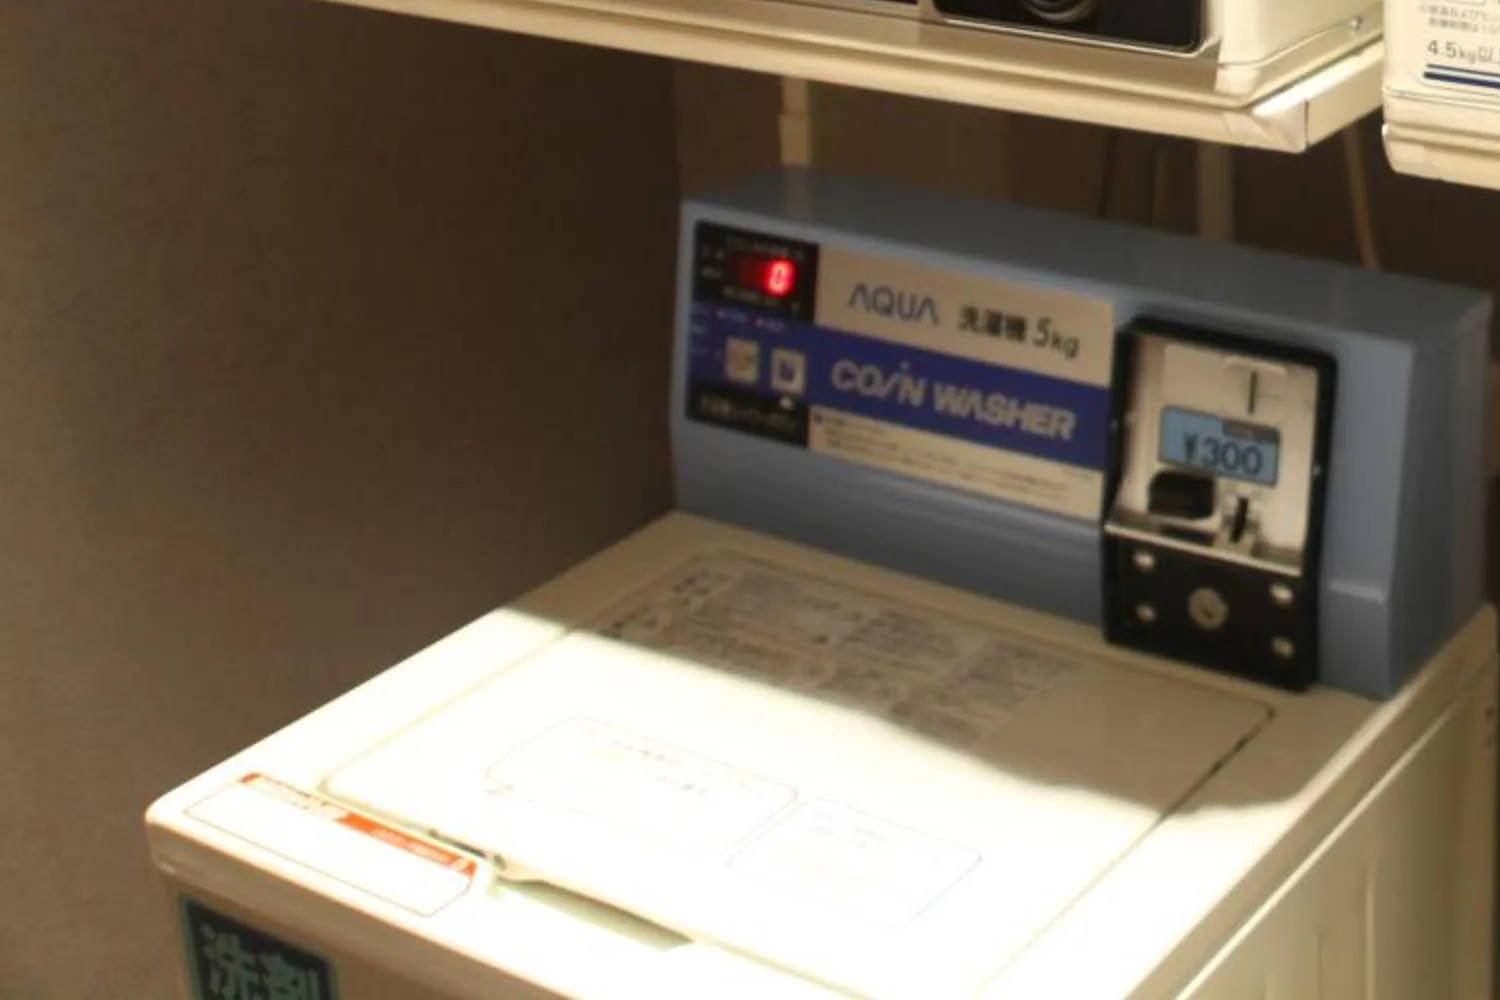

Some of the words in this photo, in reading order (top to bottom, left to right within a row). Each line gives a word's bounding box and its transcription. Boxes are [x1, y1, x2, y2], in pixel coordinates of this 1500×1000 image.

[848, 282, 940, 326] AQUA
[830, 359, 927, 407] COIN
[933, 382, 1078, 441] WASHER
[1183, 431, 1263, 476] ¥300
